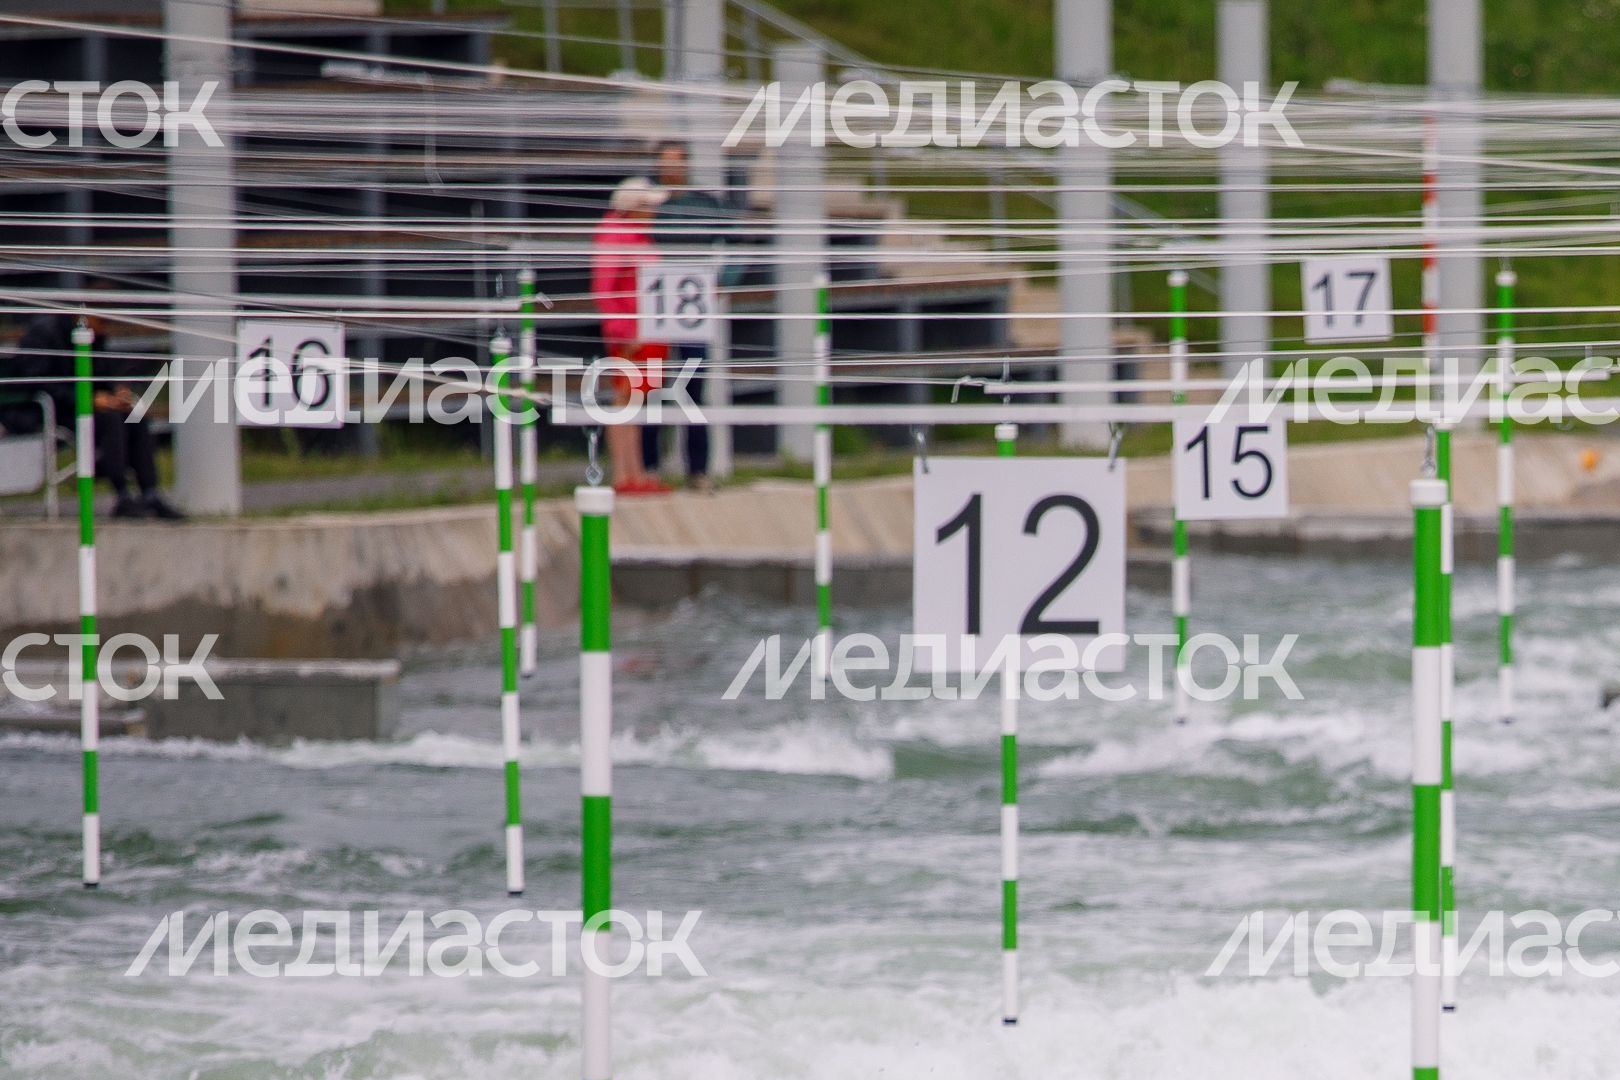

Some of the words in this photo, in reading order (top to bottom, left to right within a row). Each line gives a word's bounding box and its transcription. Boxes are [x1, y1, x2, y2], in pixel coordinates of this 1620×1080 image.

[647, 276, 706, 330] 18
[1311, 270, 1377, 328] 17
[248, 337, 331, 408] 16
[1185, 425, 1273, 499] 15
[937, 493, 1100, 635] 12
